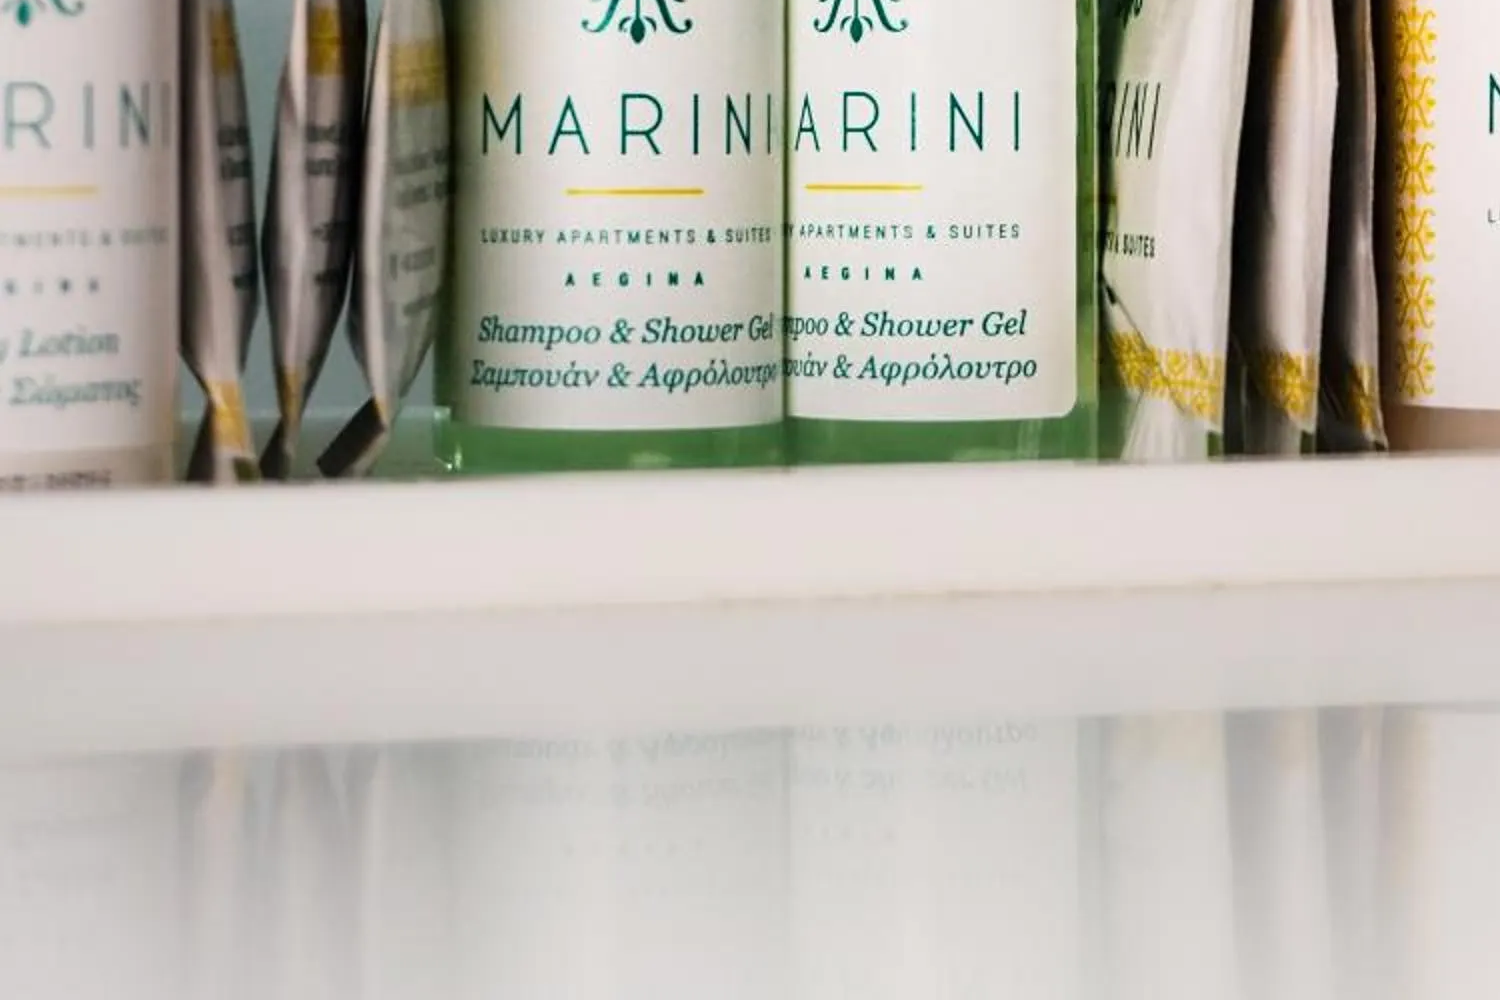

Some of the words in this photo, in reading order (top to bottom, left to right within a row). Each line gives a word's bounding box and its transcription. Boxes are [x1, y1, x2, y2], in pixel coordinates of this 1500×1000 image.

[4, 81, 171, 150] RINI
[481, 92, 772, 155] MARINI
[795, 90, 1020, 152] ARINI
[480, 228, 545, 244] LUXURY
[556, 228, 696, 244] APARTMENTS
[706, 228, 716, 244] &
[725, 227, 771, 244] SUITES
[799, 223, 913, 240] APARTMENTS
[925, 223, 936, 239] &
[950, 223, 1021, 240] SUITES
[565, 272, 705, 287] AEGINA
[804, 265, 923, 281] AEGINA
[477, 315, 601, 349] Shampoo
[609, 318, 635, 344] &
[641, 316, 743, 344] Shower
[748, 312, 774, 342] Gel
[835, 311, 855, 336] &
[860, 310, 974, 337] Shower
[981, 309, 1028, 336] Gel
[471, 359, 600, 389] Σαμπουάν
[607, 361, 633, 388] &
[833, 354, 853, 379] &
[857, 354, 1037, 386] Αφρόλουτρο
